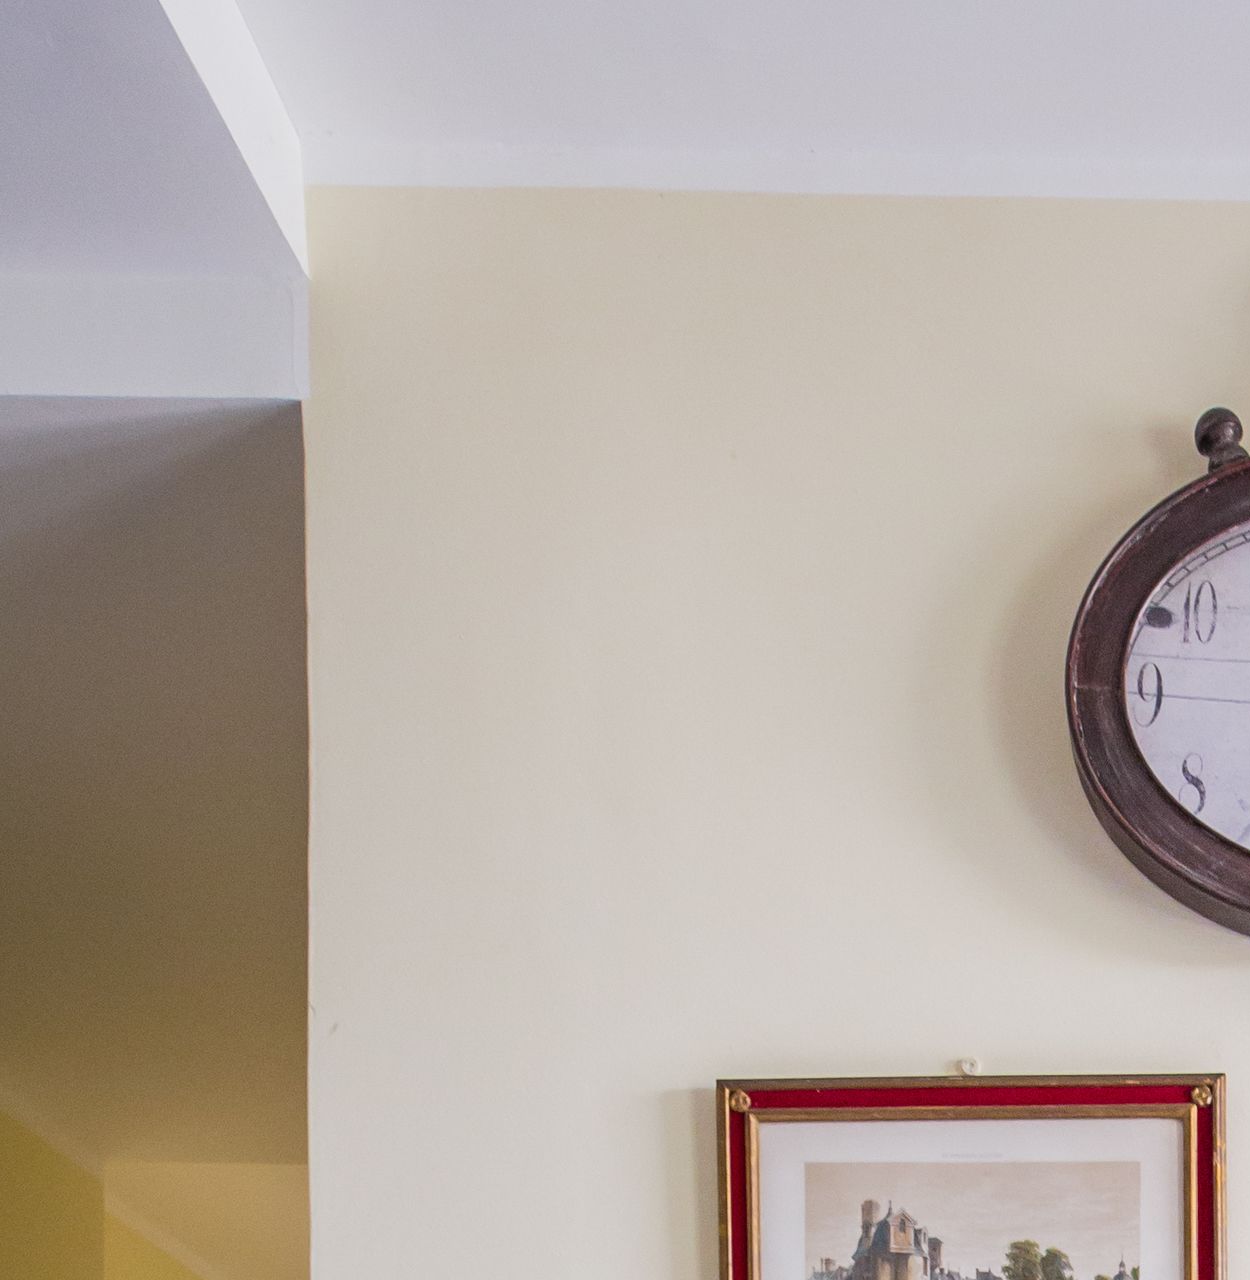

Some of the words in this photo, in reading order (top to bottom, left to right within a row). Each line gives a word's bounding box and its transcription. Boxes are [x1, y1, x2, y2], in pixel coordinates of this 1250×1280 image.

[1183, 580, 1218, 644] 10
[1133, 662, 1164, 727] 9
[1178, 753, 1206, 815] 8
